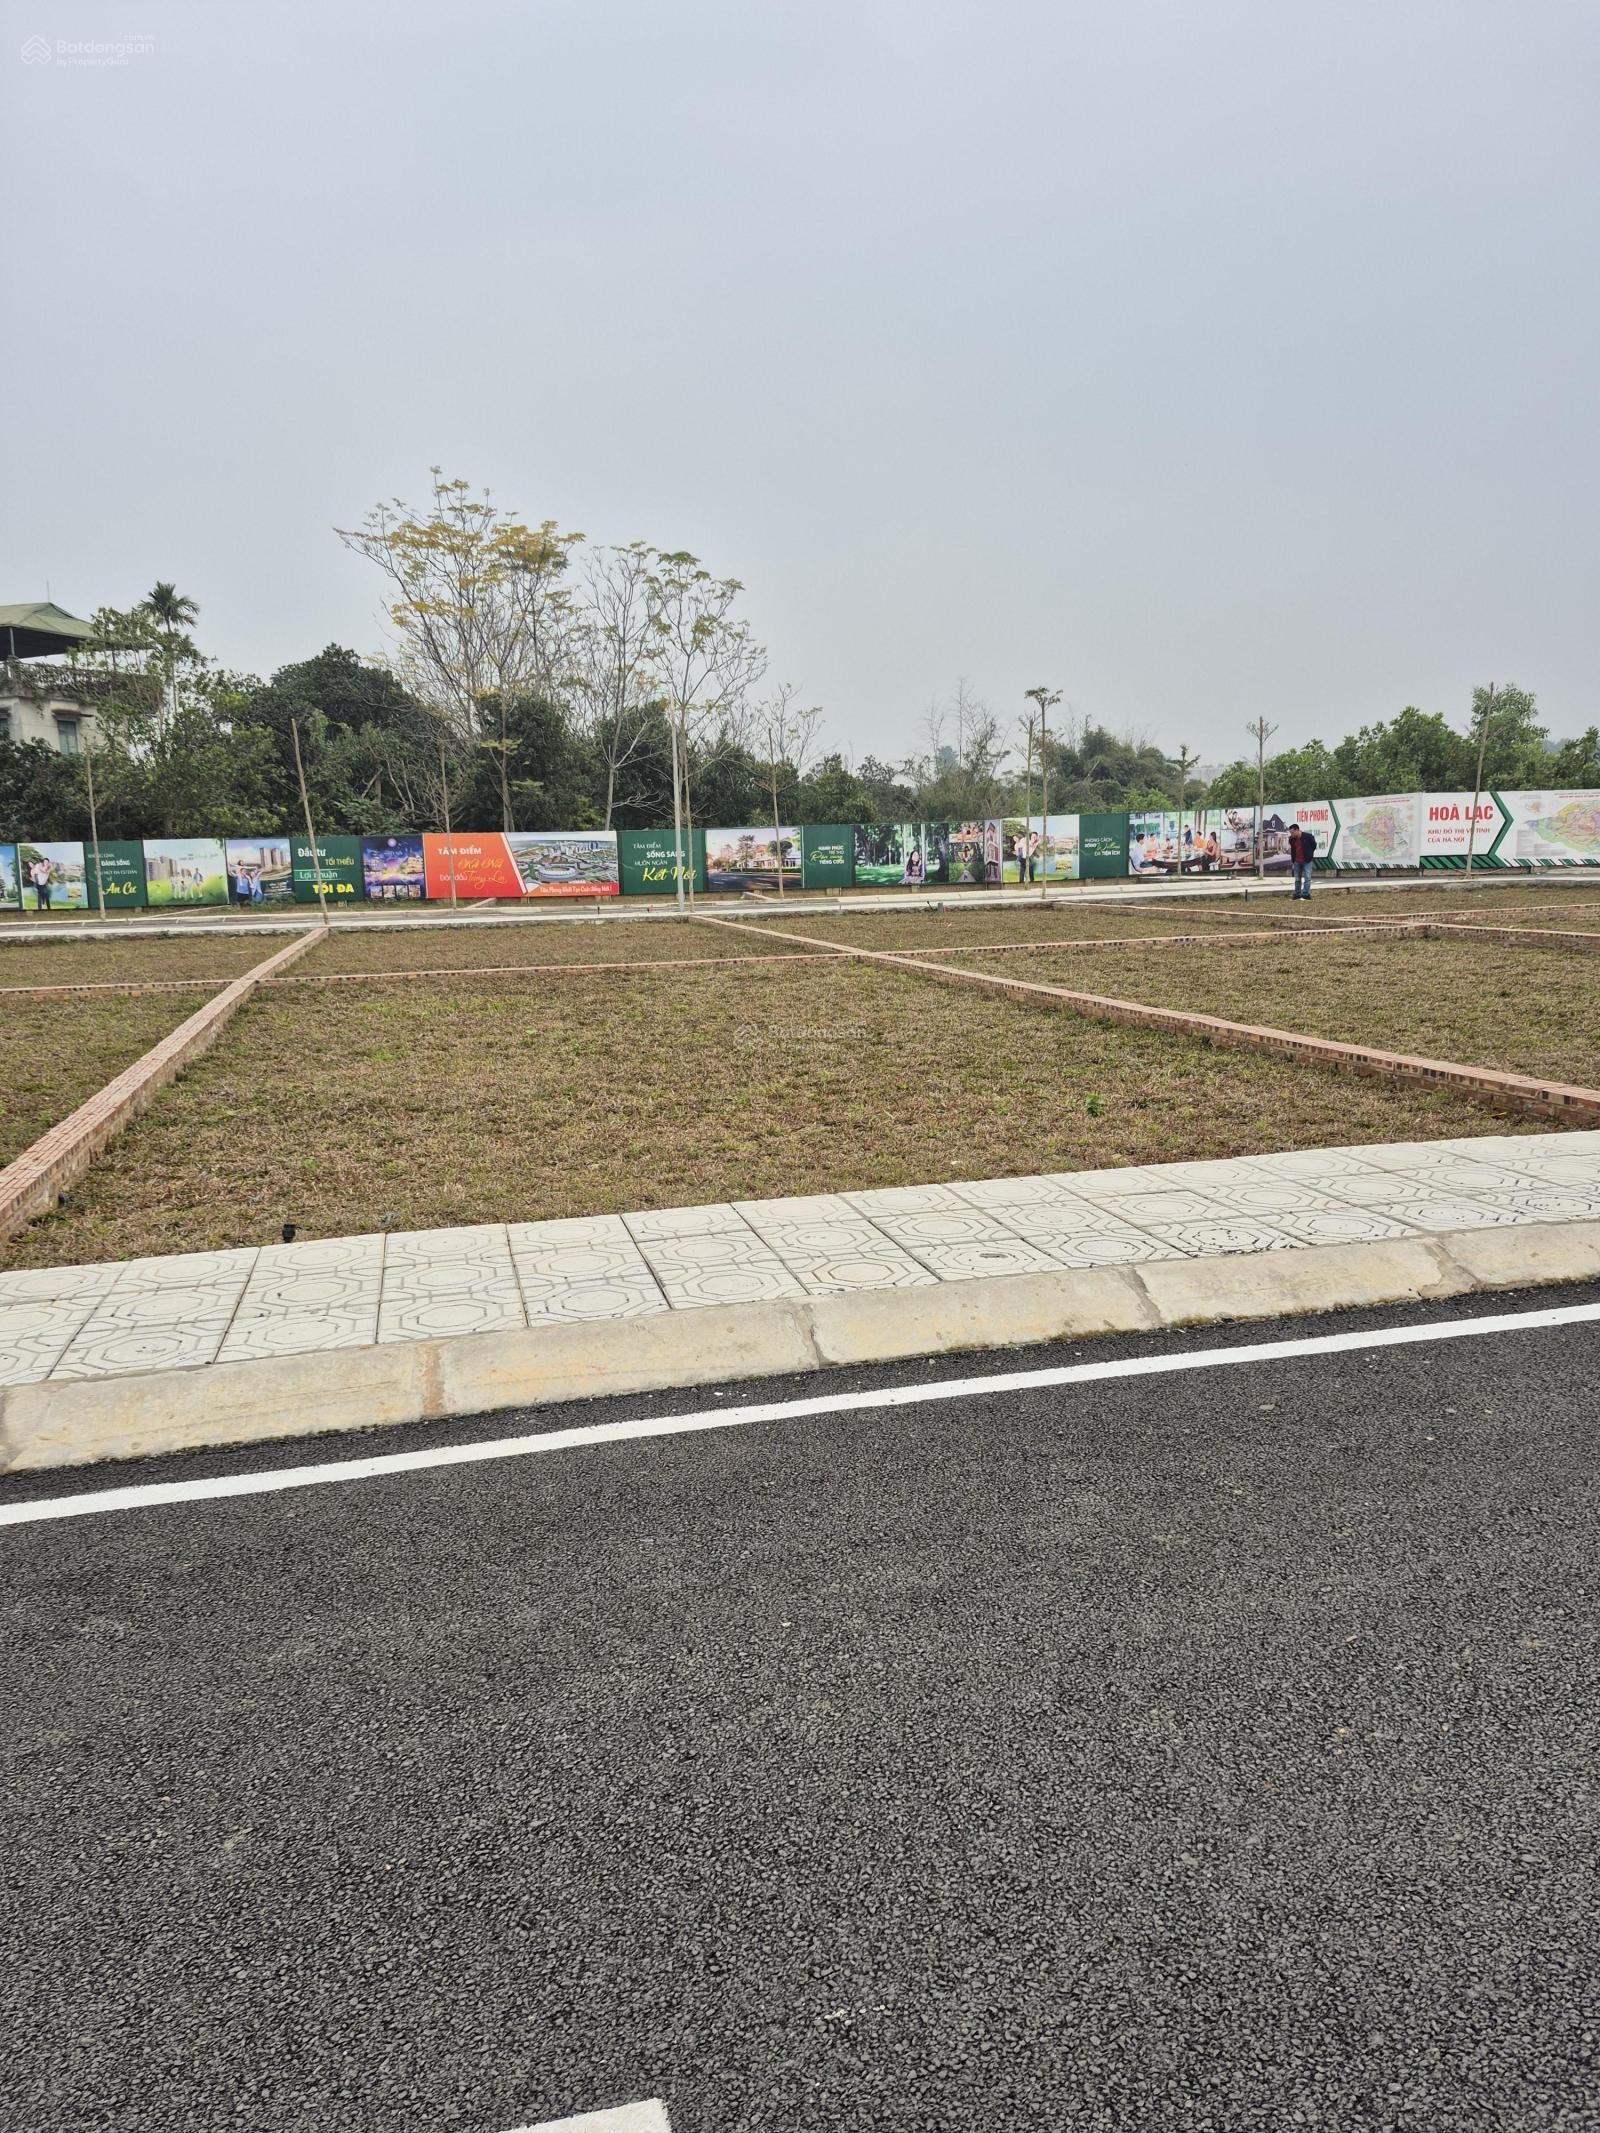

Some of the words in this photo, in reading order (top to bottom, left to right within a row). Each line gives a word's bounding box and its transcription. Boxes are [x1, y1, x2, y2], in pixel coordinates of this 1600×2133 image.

[1309, 809, 1329, 821] PHONG
[1465, 805, 1494, 823] LẠC
[1442, 827, 1454, 835] ĐÔ
[438, 846, 458, 856] TÂM
[459, 844, 482, 855] ĐIỂM
[646, 841, 661, 849] ĐIỂM
[298, 847, 315, 858] Đầu
[317, 847, 327, 857] tư
[646, 849, 666, 858] SỐNG
[325, 857, 336, 866] TỐI
[336, 856, 355, 866] THIỂU
[300, 871, 312, 880] Lợi
[642, 866, 669, 882] Kết
[102, 882, 121, 896] An
[312, 881, 334, 894] TỐI
[337, 883, 355, 893] ĐA
